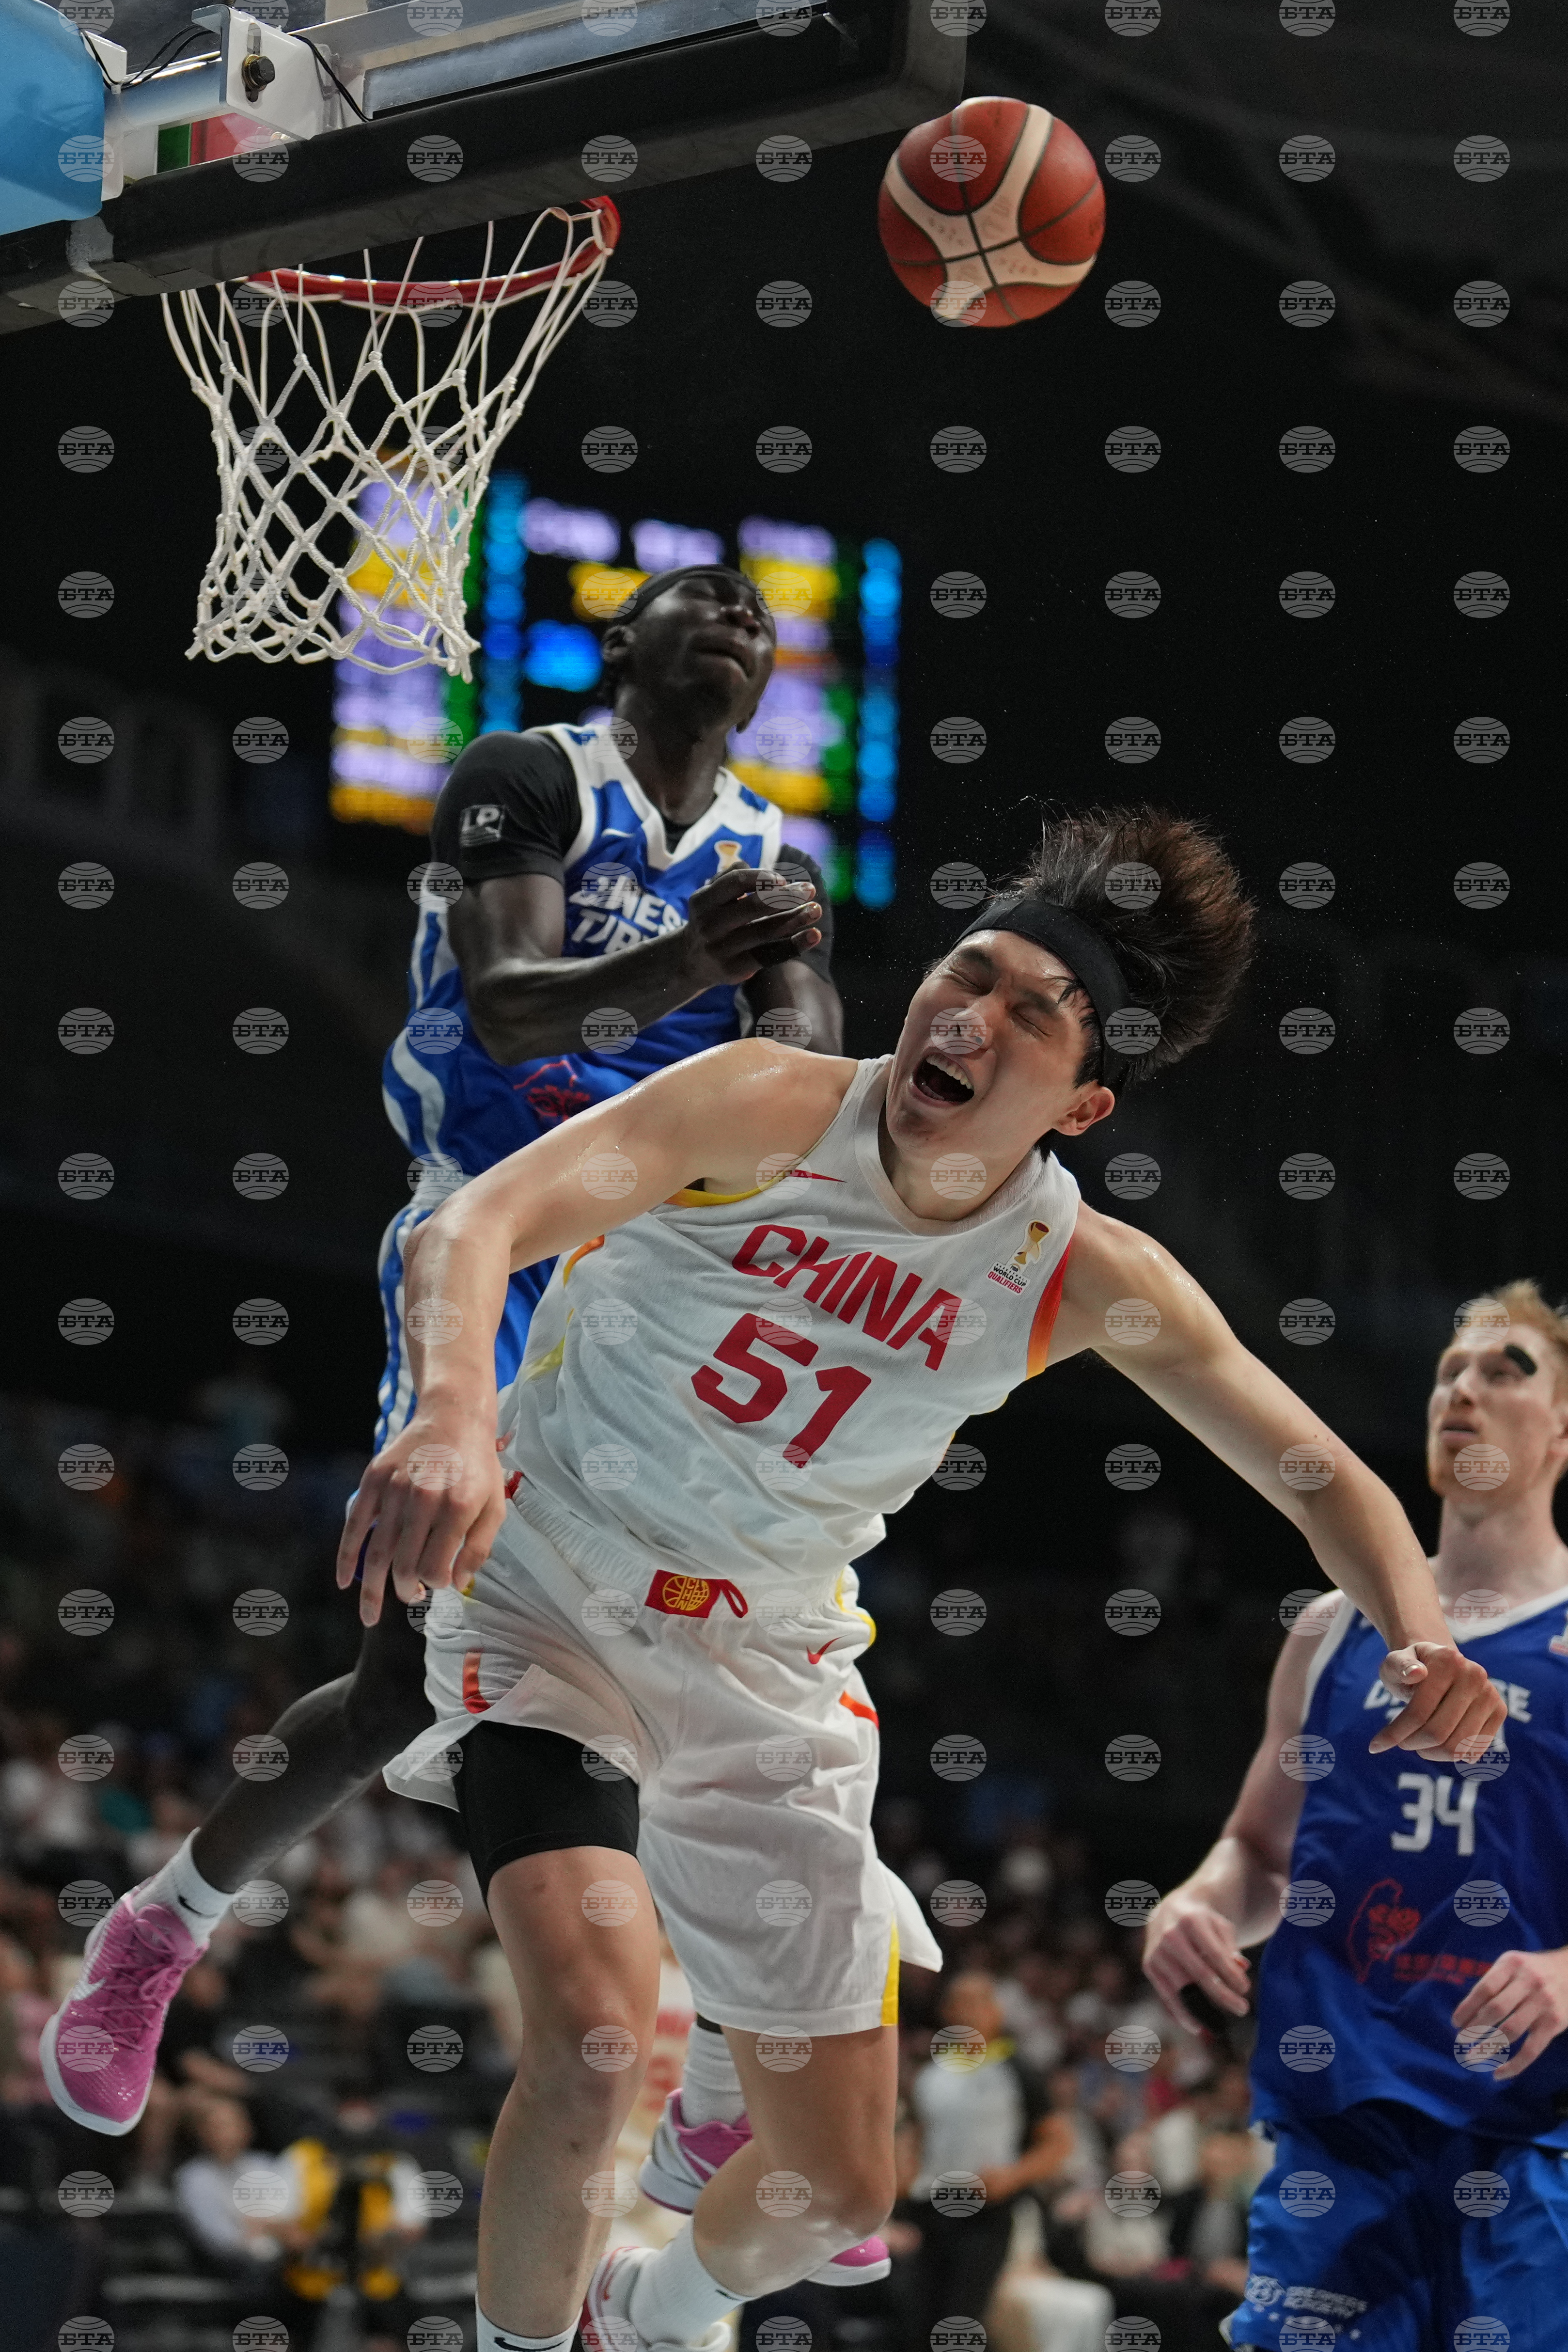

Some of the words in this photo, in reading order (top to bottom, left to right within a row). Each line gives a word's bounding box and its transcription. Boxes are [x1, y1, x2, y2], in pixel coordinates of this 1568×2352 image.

[732, 1224, 962, 1371] CHINA
[988, 1271, 1022, 1294] QUALIFIERS
[993, 1266, 1014, 1280] WORLD
[1014, 1278, 1026, 1286] CUP
[690, 1312, 872, 1468] 51
[1391, 1772, 1479, 1856] 34
